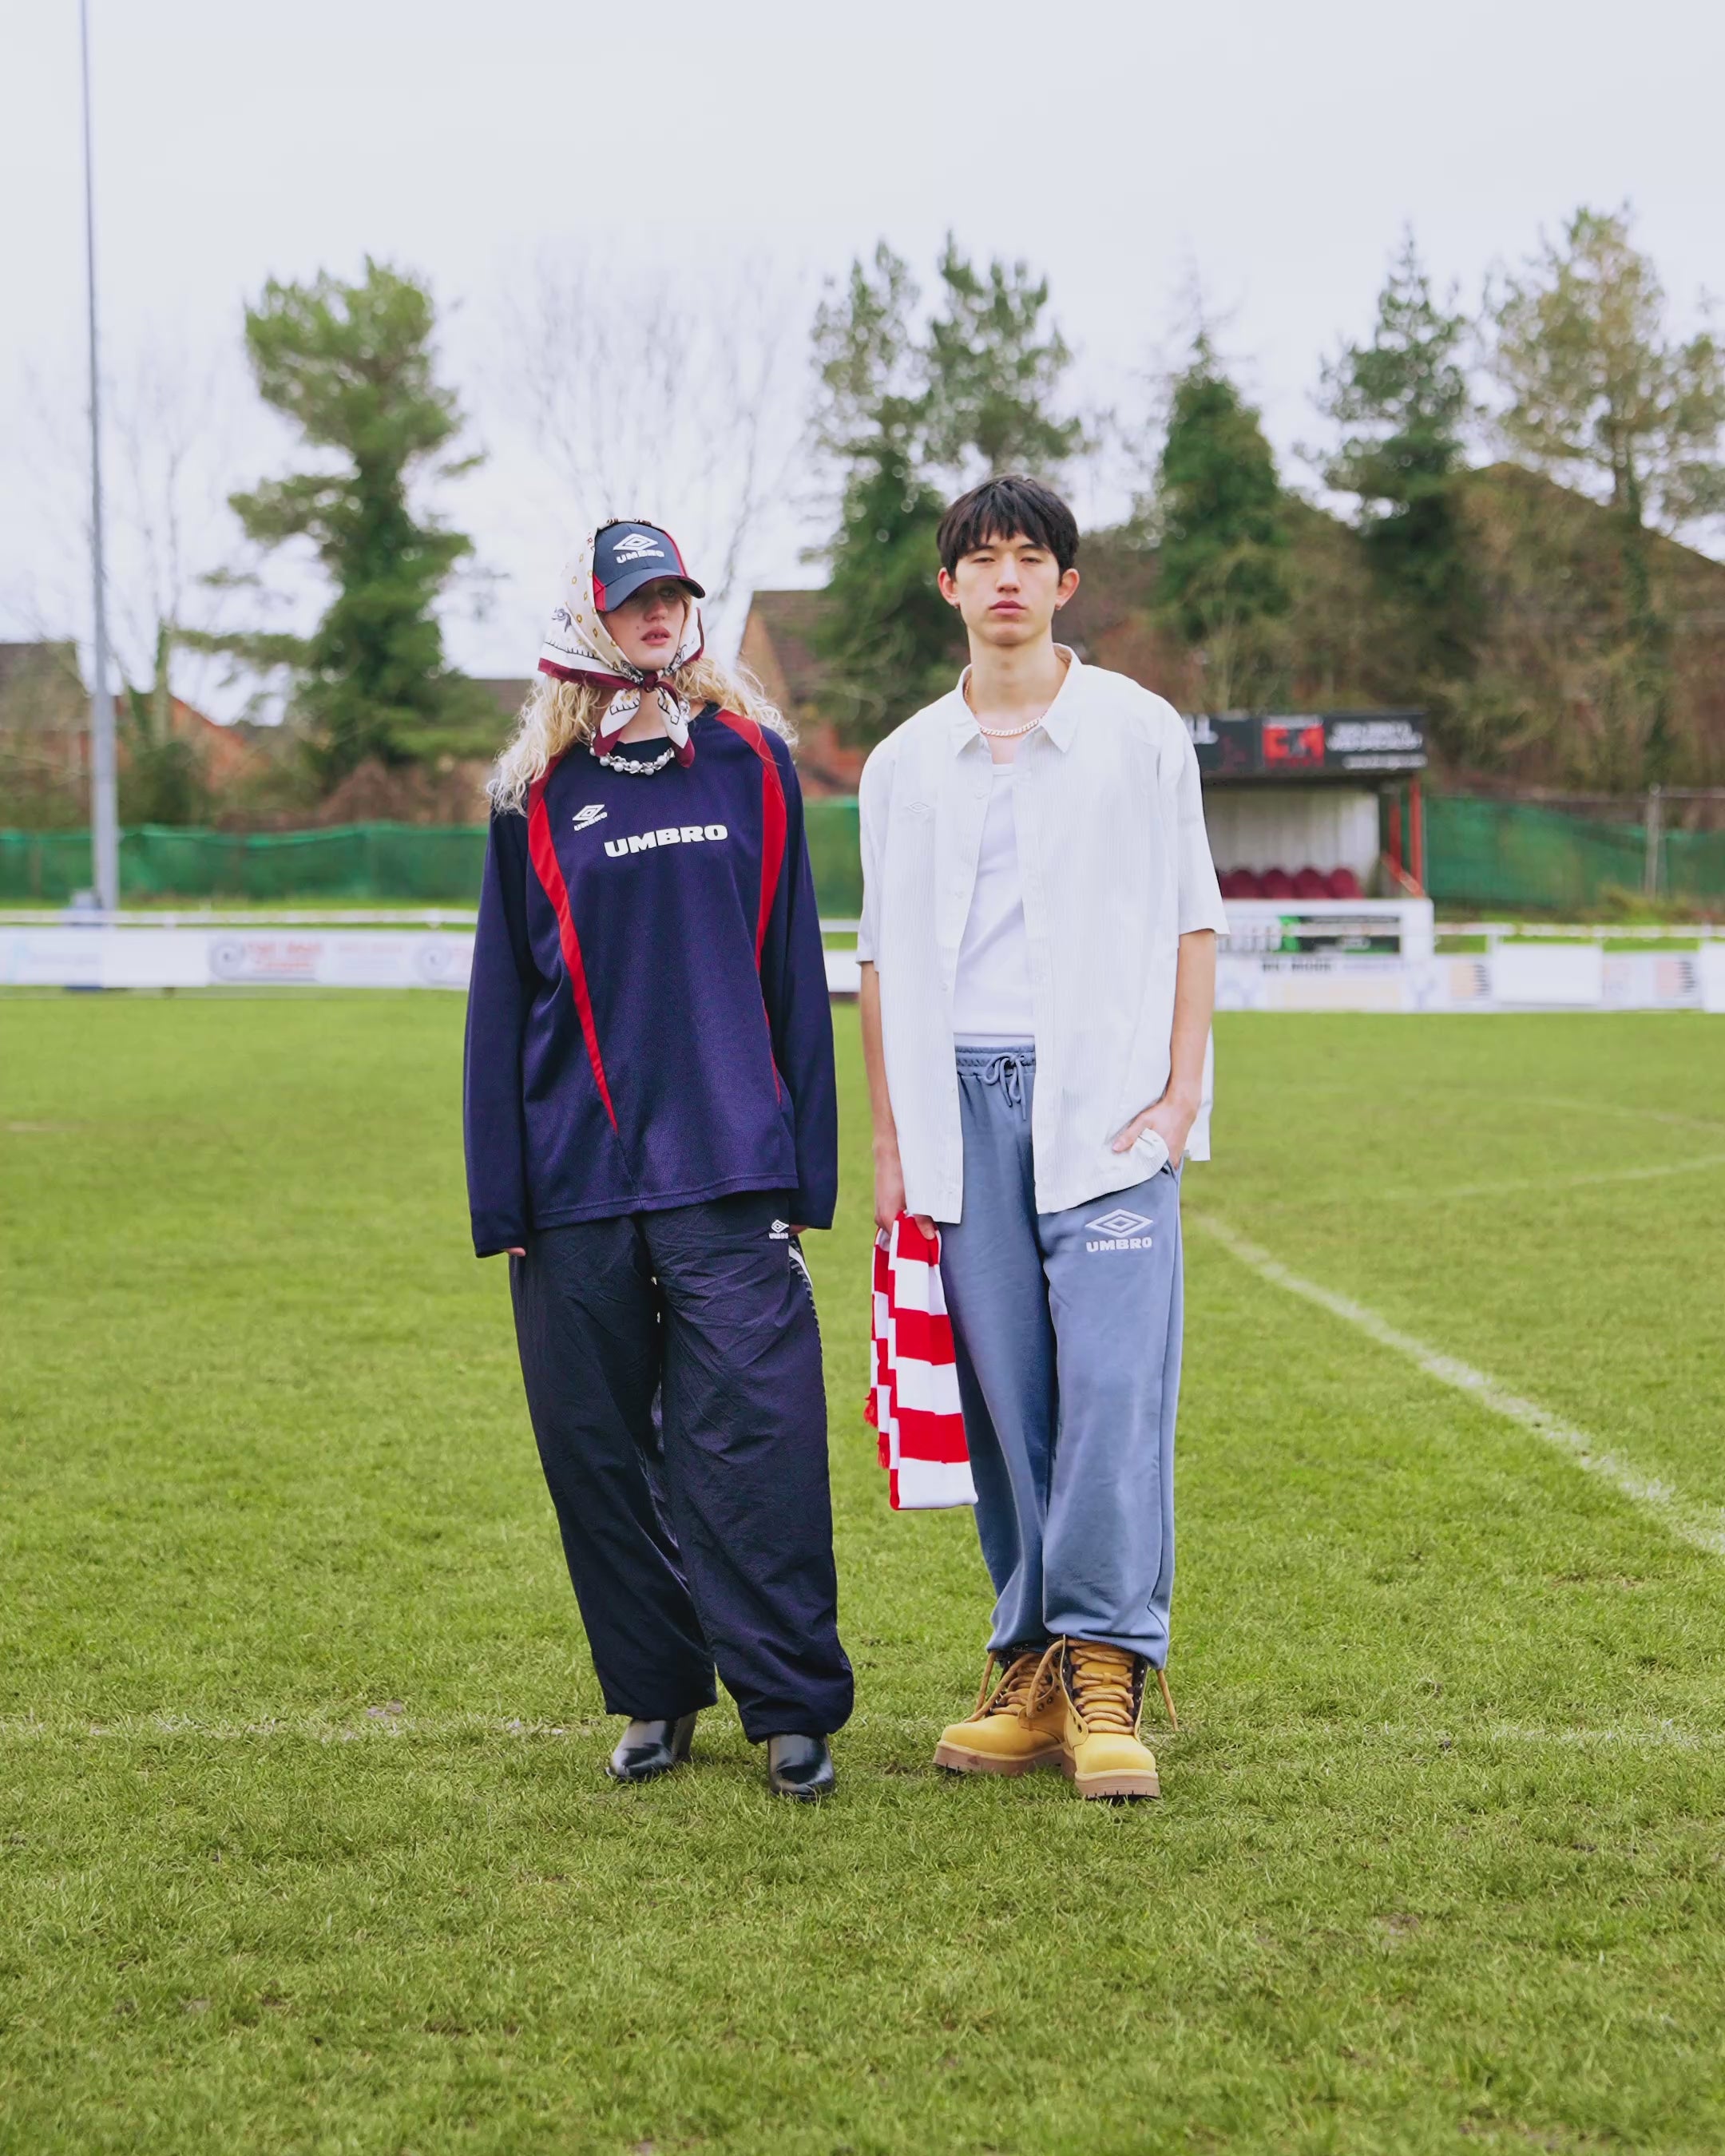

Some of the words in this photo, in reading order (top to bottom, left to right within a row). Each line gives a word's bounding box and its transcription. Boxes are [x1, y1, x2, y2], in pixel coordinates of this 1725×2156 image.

[616, 549, 664, 564] UMBRO
[604, 824, 728, 858] UMBRO
[1086, 1236, 1152, 1253] UMBRO
